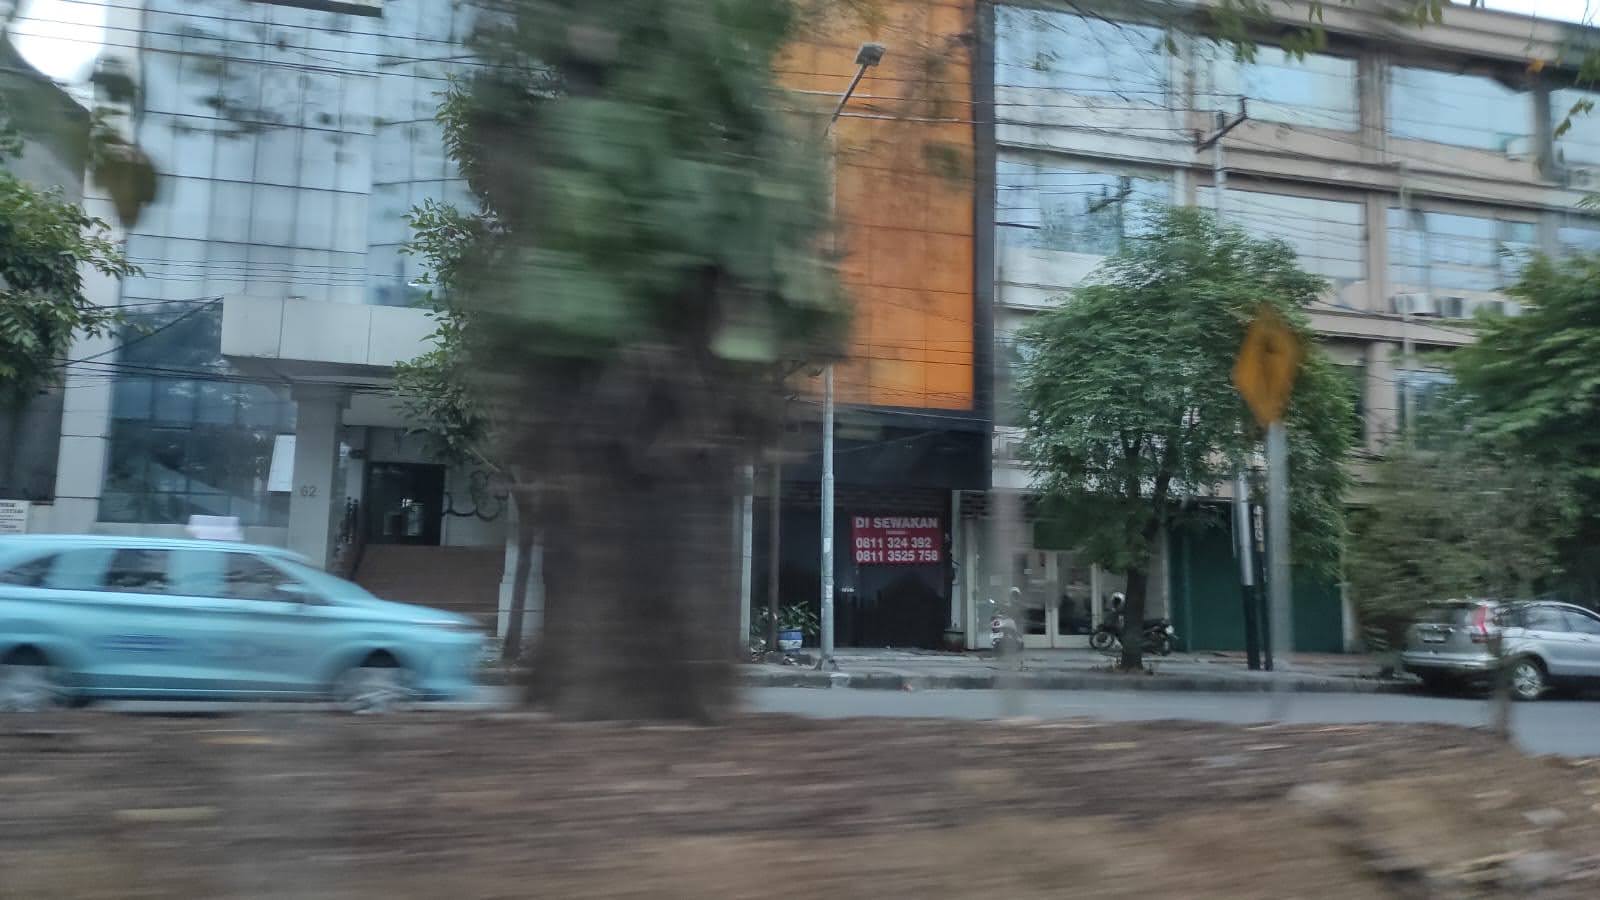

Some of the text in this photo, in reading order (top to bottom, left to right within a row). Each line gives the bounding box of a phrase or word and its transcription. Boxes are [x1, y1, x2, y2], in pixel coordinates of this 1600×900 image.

[855, 517, 938, 528] DI SEWAKAN
[855, 537, 883, 548] 0811
[887, 537, 908, 548] 324
[855, 550, 938, 561] 0811 3525 758
